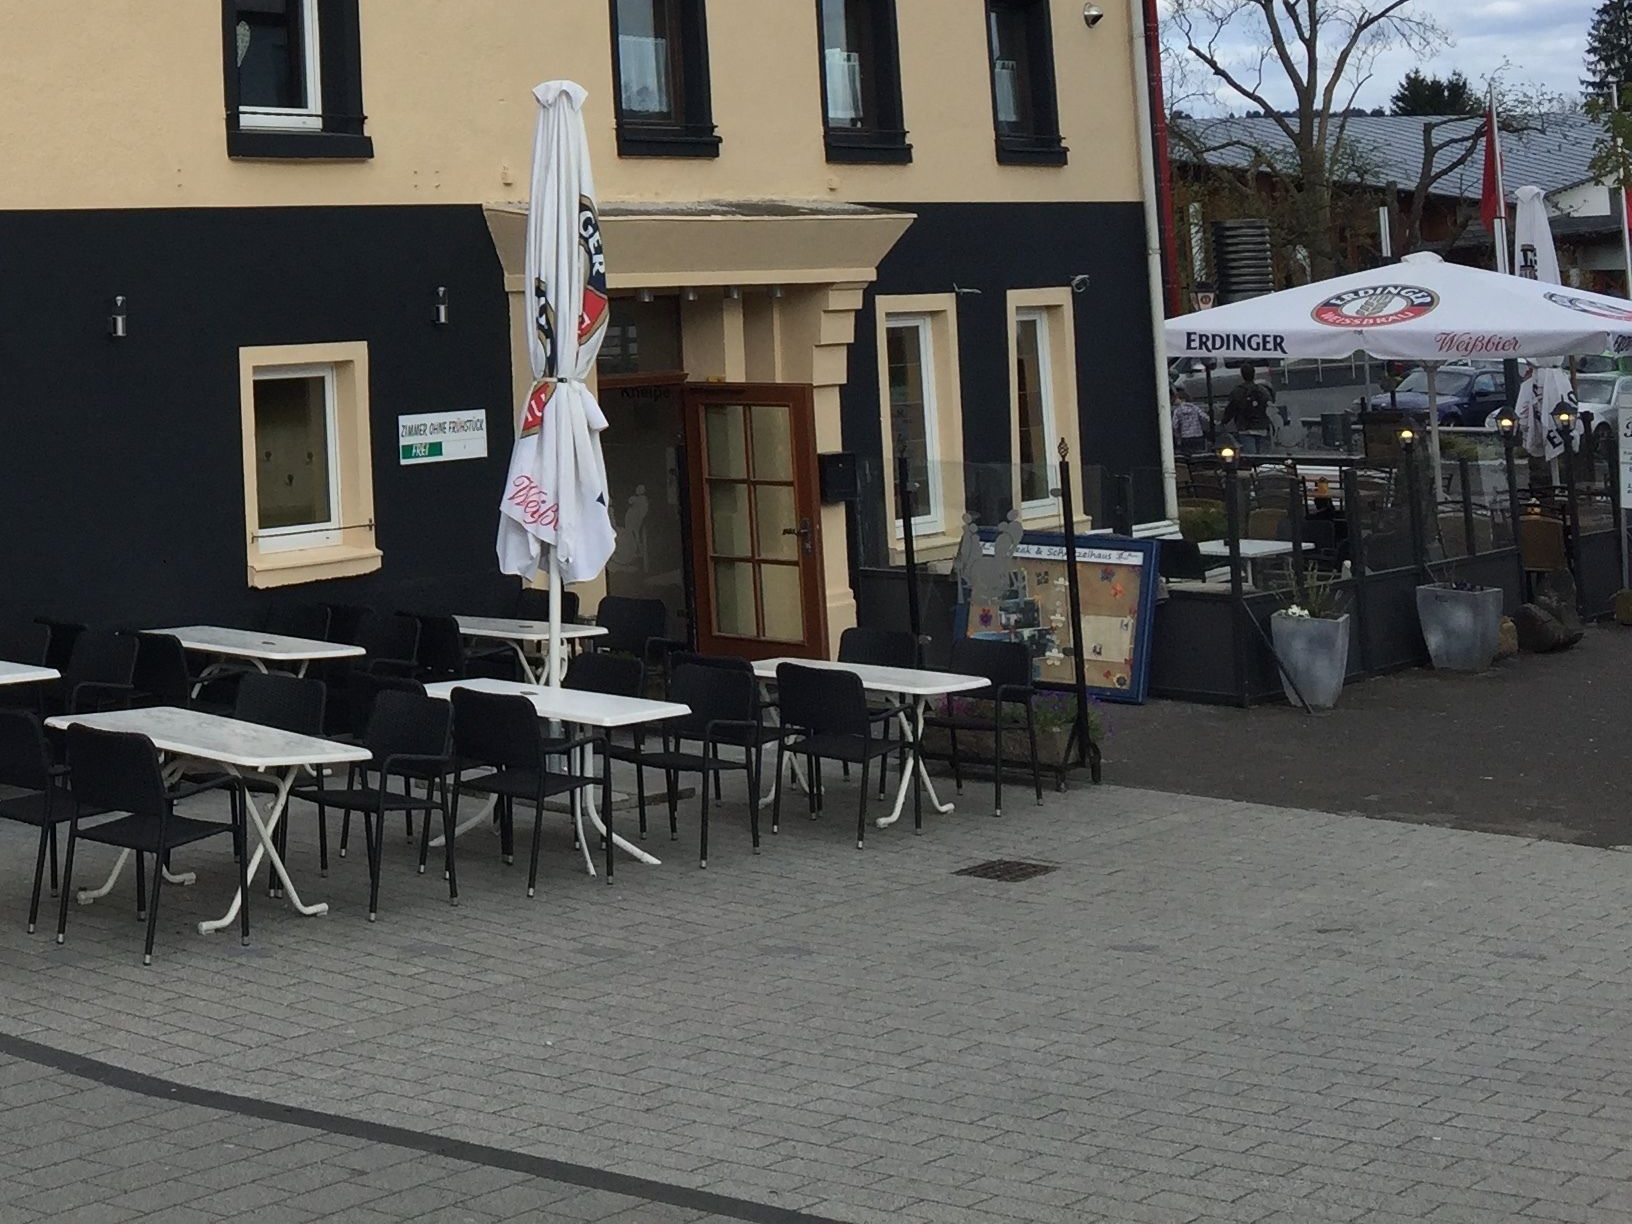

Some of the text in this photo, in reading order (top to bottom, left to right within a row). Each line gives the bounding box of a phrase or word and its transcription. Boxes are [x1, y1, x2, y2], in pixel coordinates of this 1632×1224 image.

[1186, 331, 1288, 355] ERDINGER
[1434, 330, 1521, 357] Weißbier
[401, 423, 428, 437] ZIMMER
[429, 421, 448, 435] OHNE
[412, 443, 430, 457] FREI
